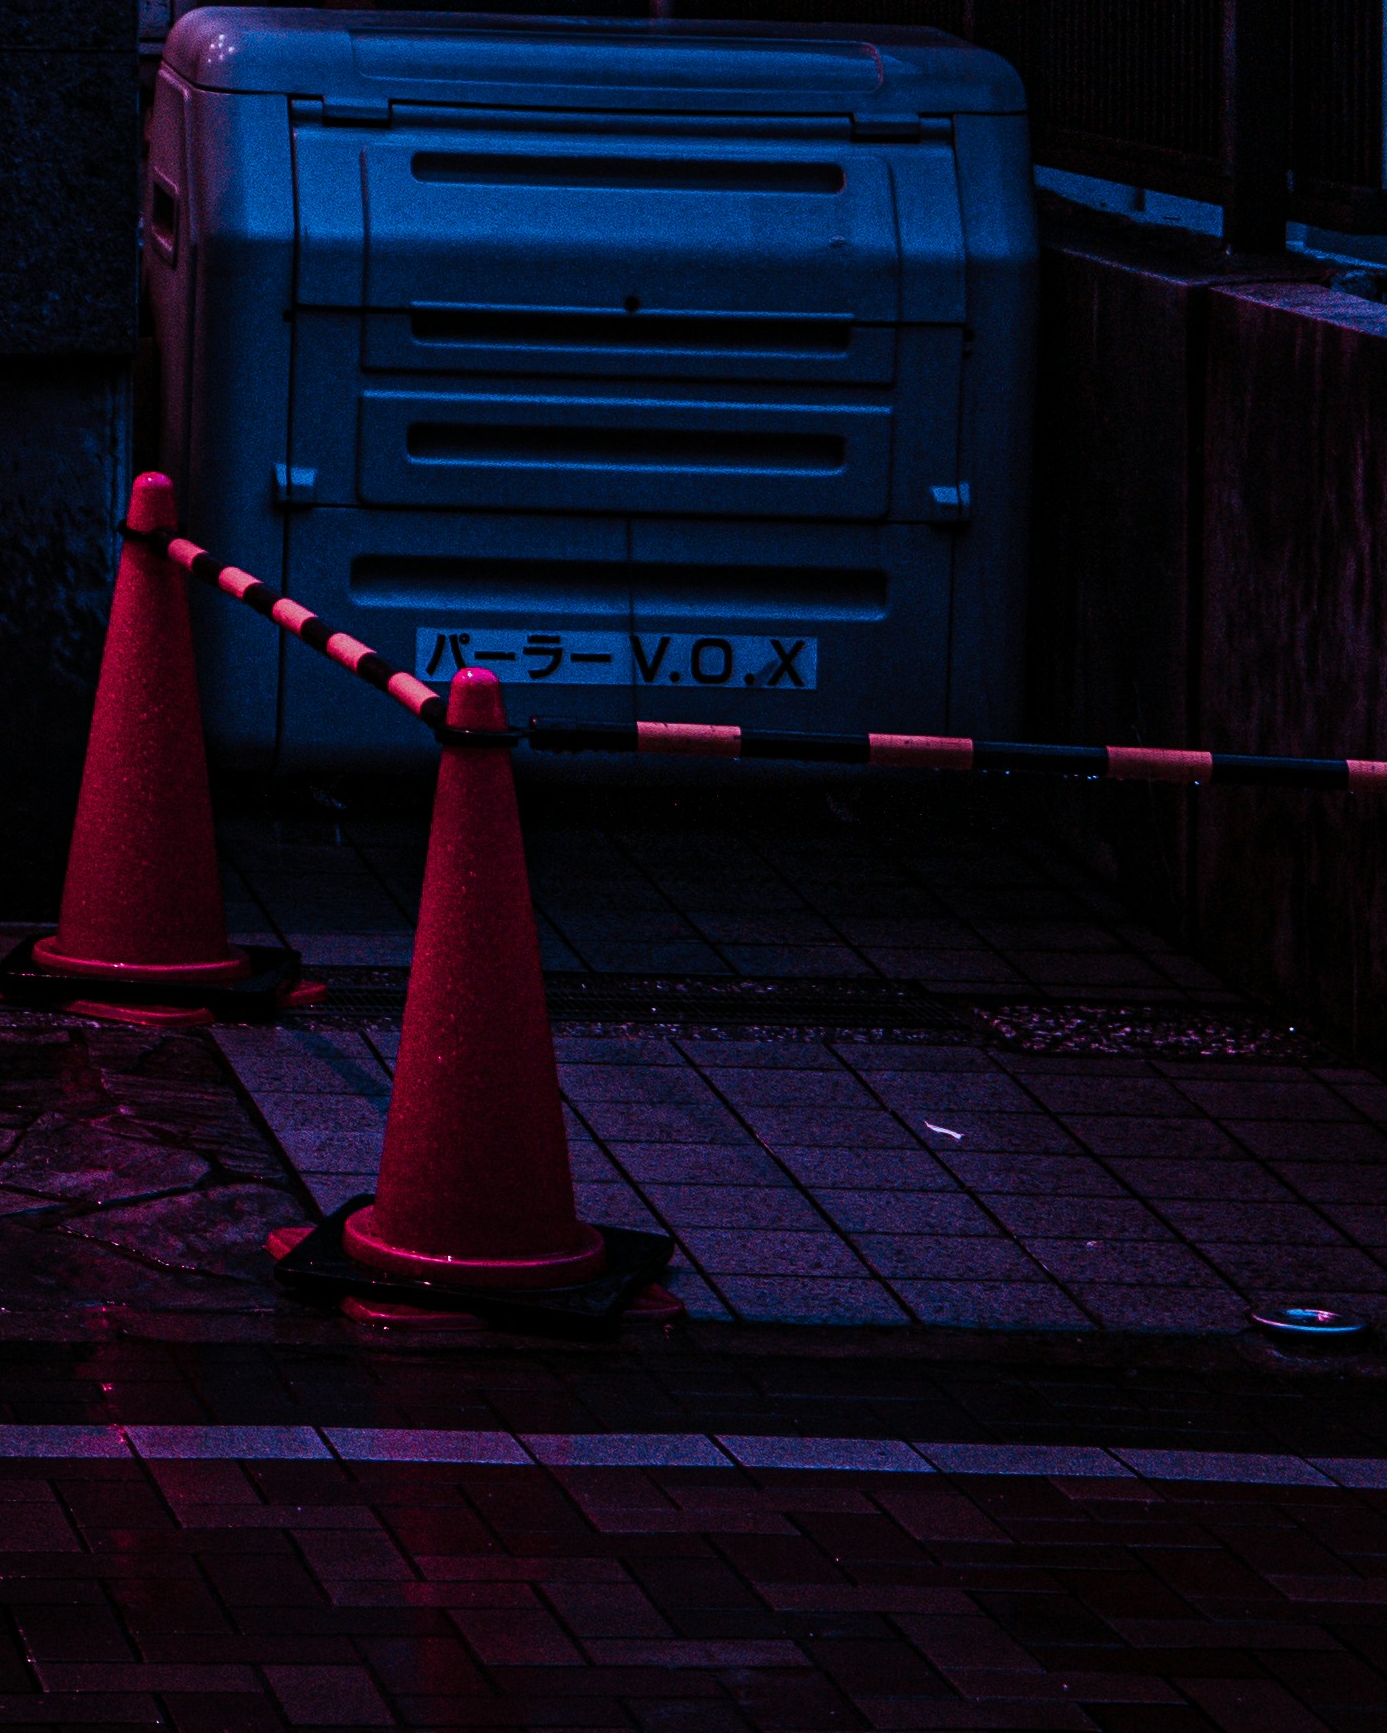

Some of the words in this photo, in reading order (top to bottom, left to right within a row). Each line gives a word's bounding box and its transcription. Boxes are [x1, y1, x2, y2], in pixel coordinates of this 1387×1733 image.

[425, 632, 612, 680] パーラー
[631, 635, 807, 687] V.O.X
